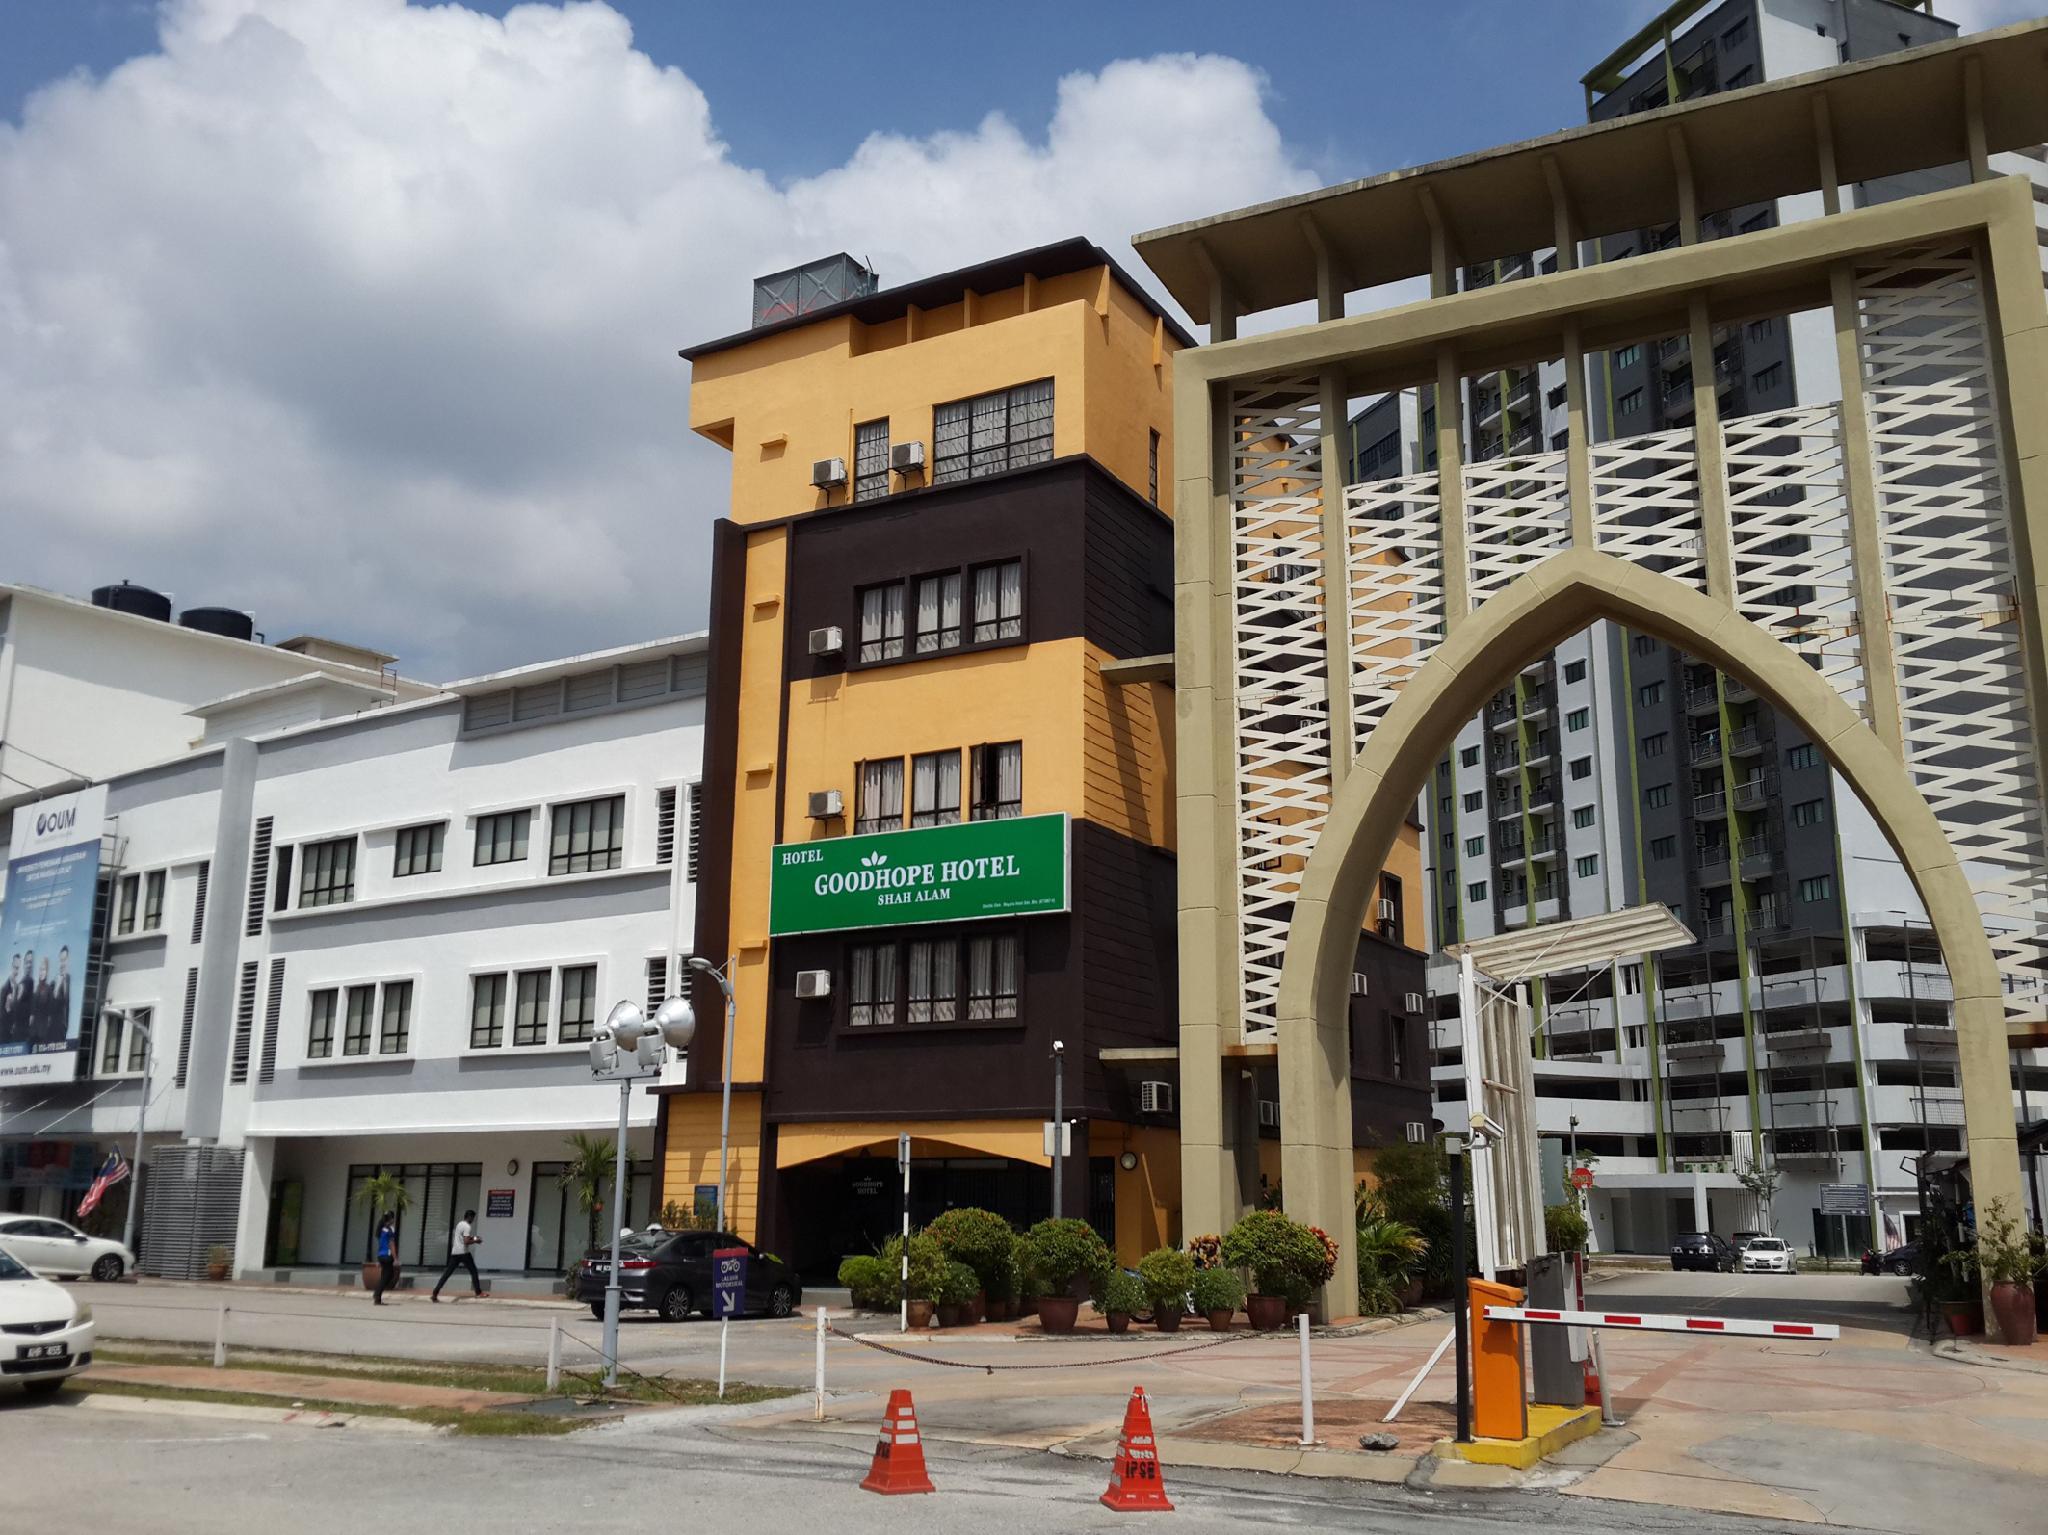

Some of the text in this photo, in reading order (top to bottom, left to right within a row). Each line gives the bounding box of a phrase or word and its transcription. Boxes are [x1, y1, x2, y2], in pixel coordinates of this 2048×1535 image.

[47, 807, 76, 832] OUM
[782, 849, 824, 865] HOTEL
[814, 855, 1020, 896] GOODHOPE HOTEL
[877, 888, 951, 906] SHAH ALAM
